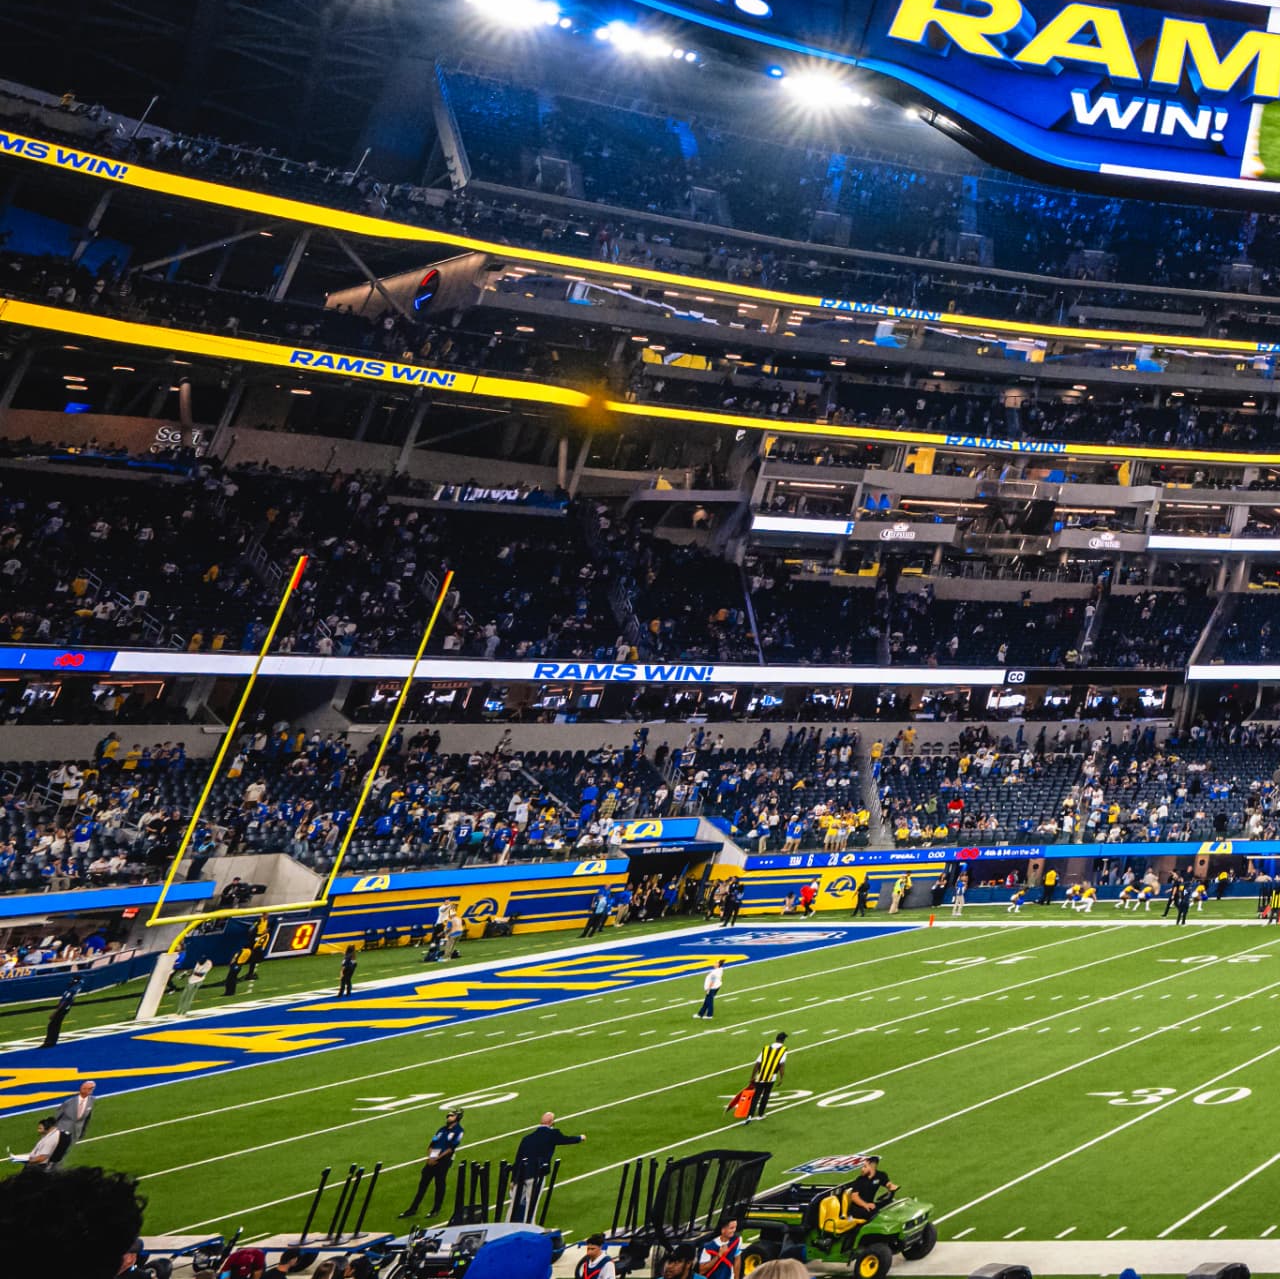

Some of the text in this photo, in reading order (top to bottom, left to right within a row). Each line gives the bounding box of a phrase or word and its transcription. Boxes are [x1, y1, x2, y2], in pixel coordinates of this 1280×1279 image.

[1070, 89, 1229, 142] WIN!
[58, 151, 126, 176] WIN!
[291, 352, 454, 384] RAMS WIN!
[946, 436, 1065, 452] RAMS WIN!
[533, 663, 713, 682] RAMS WIN!
[1010, 673, 1023, 681] CC
[291, 923, 315, 950] 0
[352, 1091, 520, 1111] 10
[1108, 1086, 1253, 1106] 30
